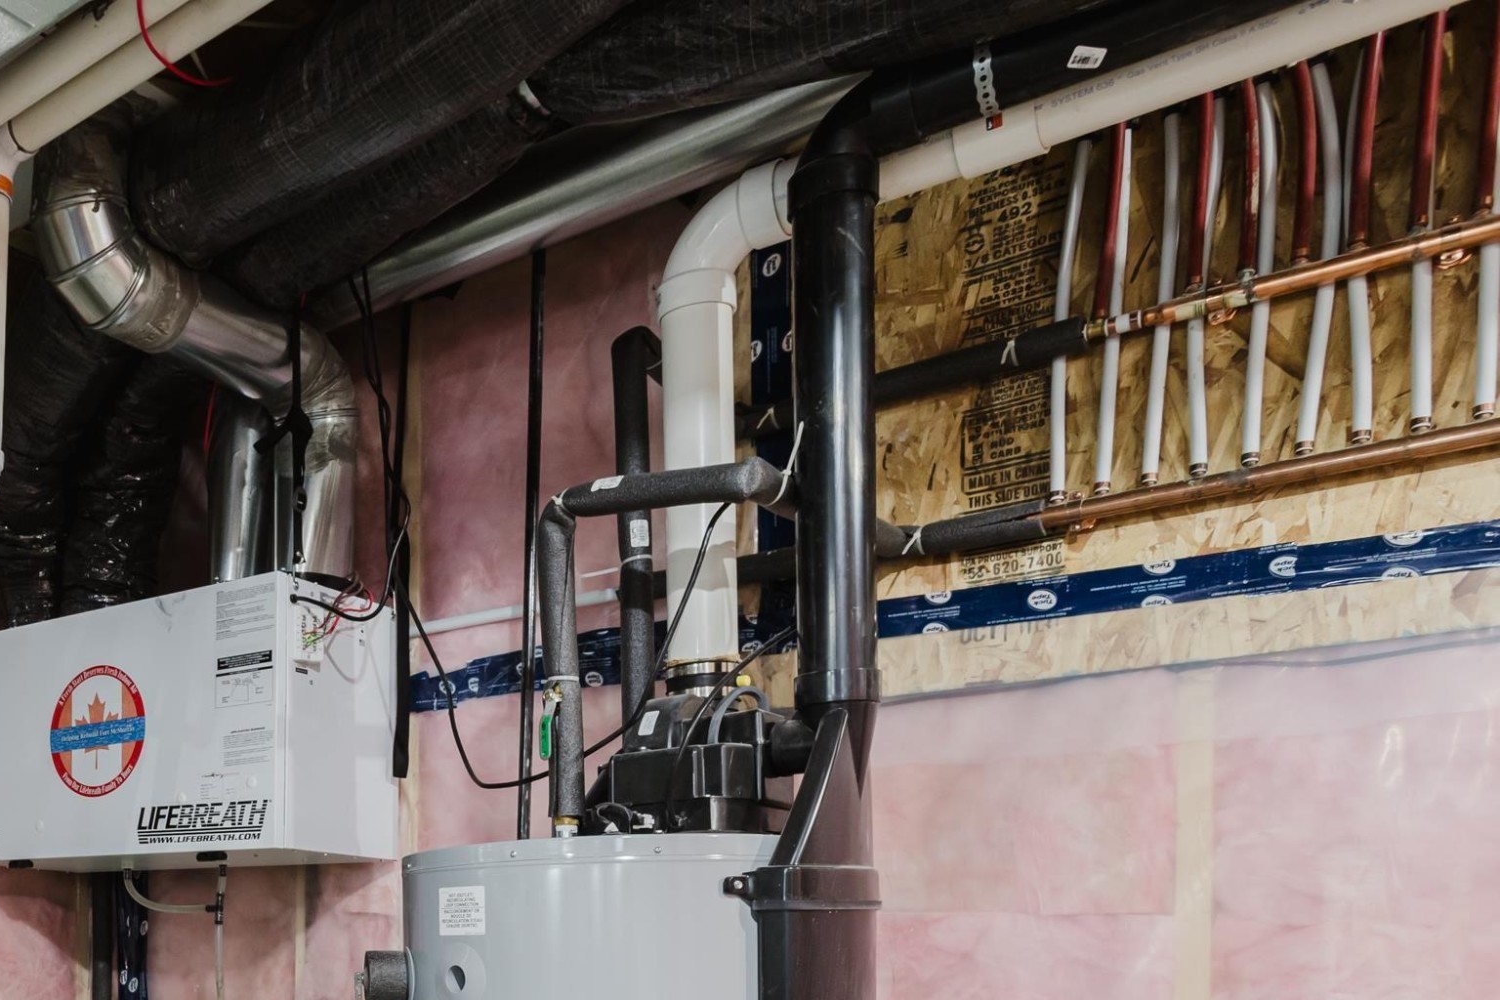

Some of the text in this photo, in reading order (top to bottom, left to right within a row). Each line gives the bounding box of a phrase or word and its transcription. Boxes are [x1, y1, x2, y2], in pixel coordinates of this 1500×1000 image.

[997, 202, 1032, 223] 492
[968, 473, 998, 490] MADE
[1000, 470, 1011, 485] IN
[968, 492, 992, 509] THIS
[995, 486, 1020, 503] SIDE
[978, 550, 1019, 565] PRODUCT
[1020, 542, 1063, 557] SUPPORT
[1150, 560, 1172, 569] Tuck
[83, 666, 104, 679] Deserves
[137, 799, 268, 830] LIFEBREATH
[149, 832, 261, 844] WWW.LIFEBREATH.COM
